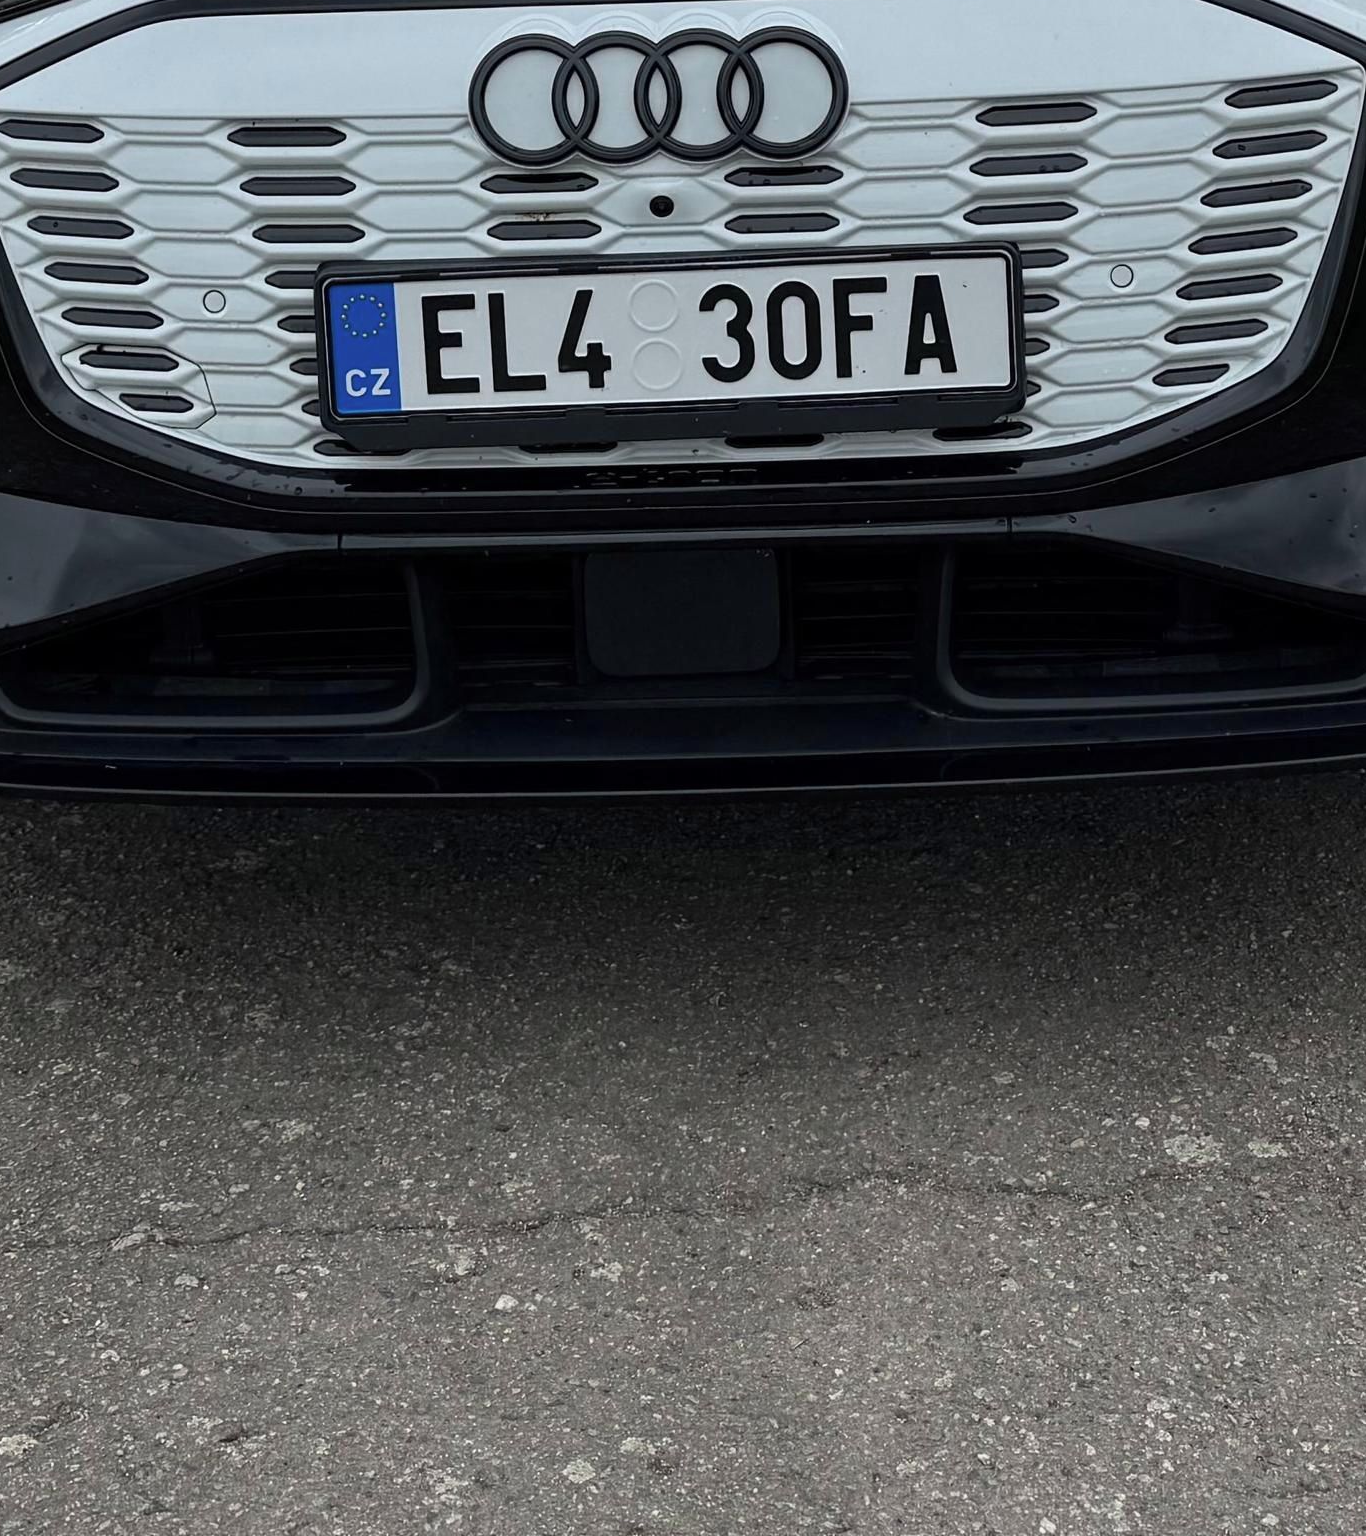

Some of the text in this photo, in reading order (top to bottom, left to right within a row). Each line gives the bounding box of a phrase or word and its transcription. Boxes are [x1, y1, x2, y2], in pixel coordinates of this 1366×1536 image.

[421, 274, 958, 395] EL4 30FA
[345, 367, 391, 397] CZ
